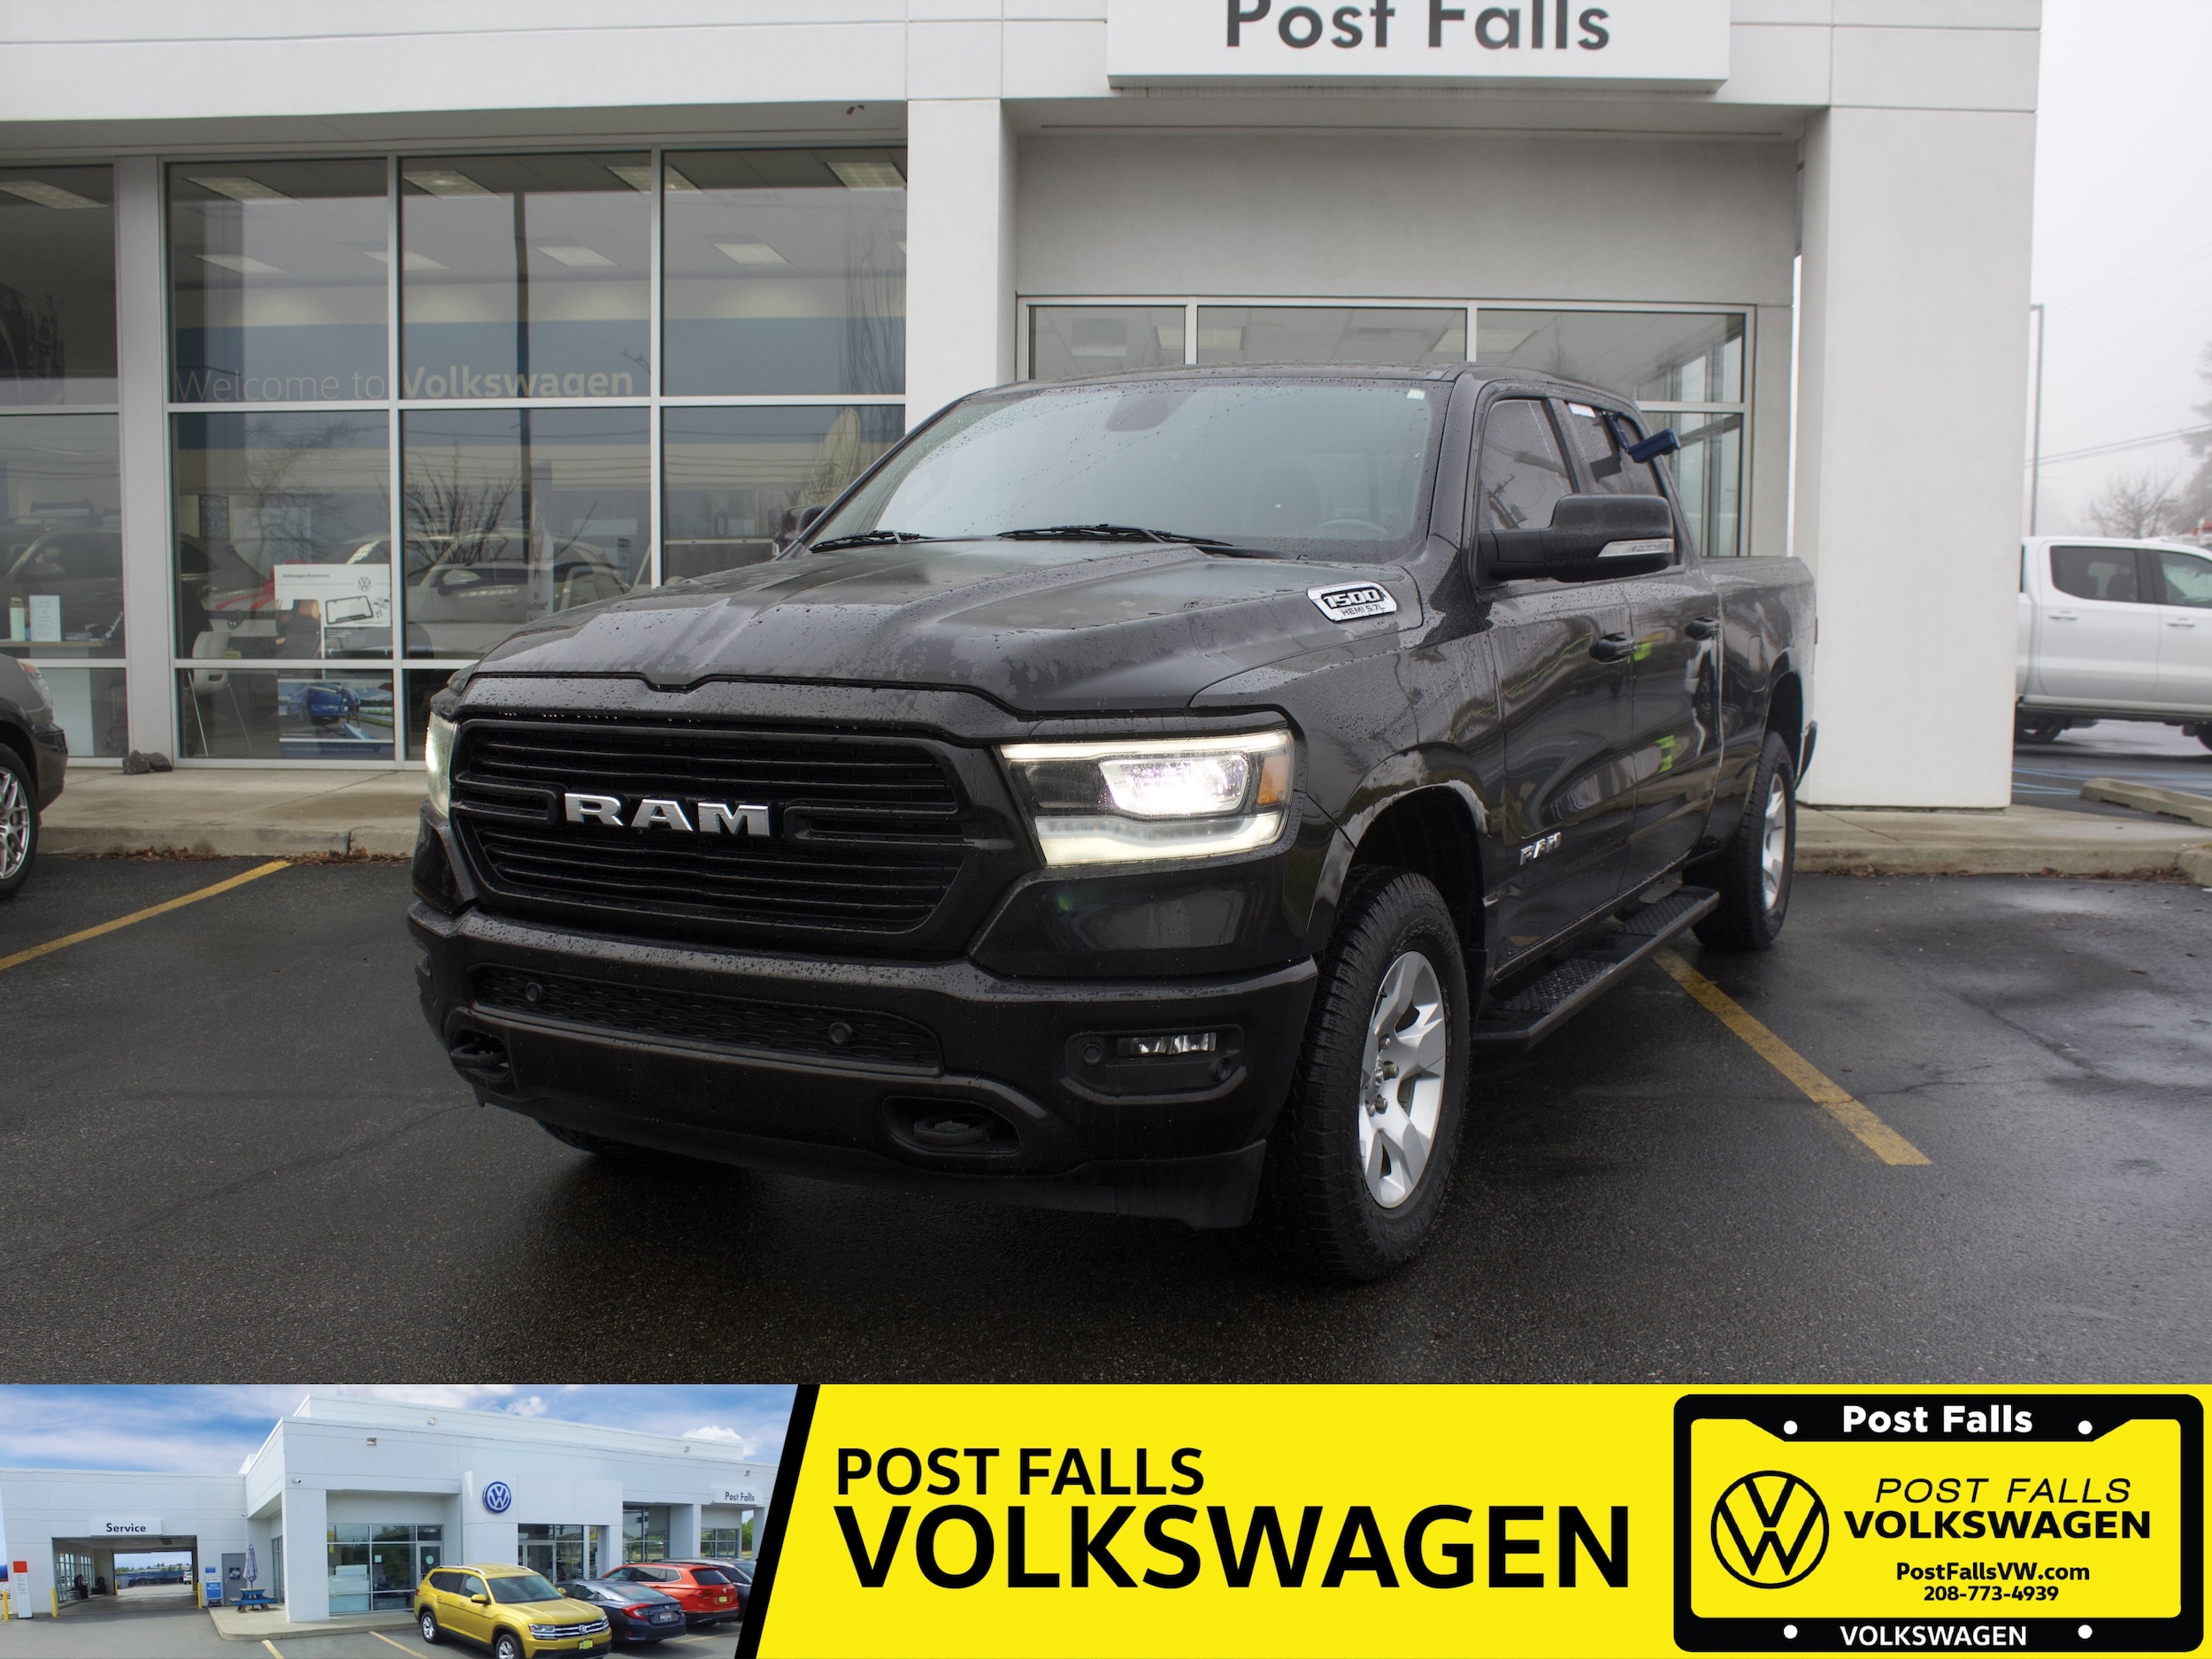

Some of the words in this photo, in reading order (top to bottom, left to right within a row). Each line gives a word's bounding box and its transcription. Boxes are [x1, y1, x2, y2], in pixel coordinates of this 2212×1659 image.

[1226, 0, 1395, 49] Post
[1428, 0, 1609, 50] Falls
[175, 369, 340, 402] Welcome
[351, 371, 385, 399] to
[403, 365, 633, 398] Volkswagen
[1323, 588, 1381, 608] 1500
[1340, 606, 1366, 617] HEMI
[1366, 603, 1386, 613] 5.7L
[565, 792, 771, 837] RAM
